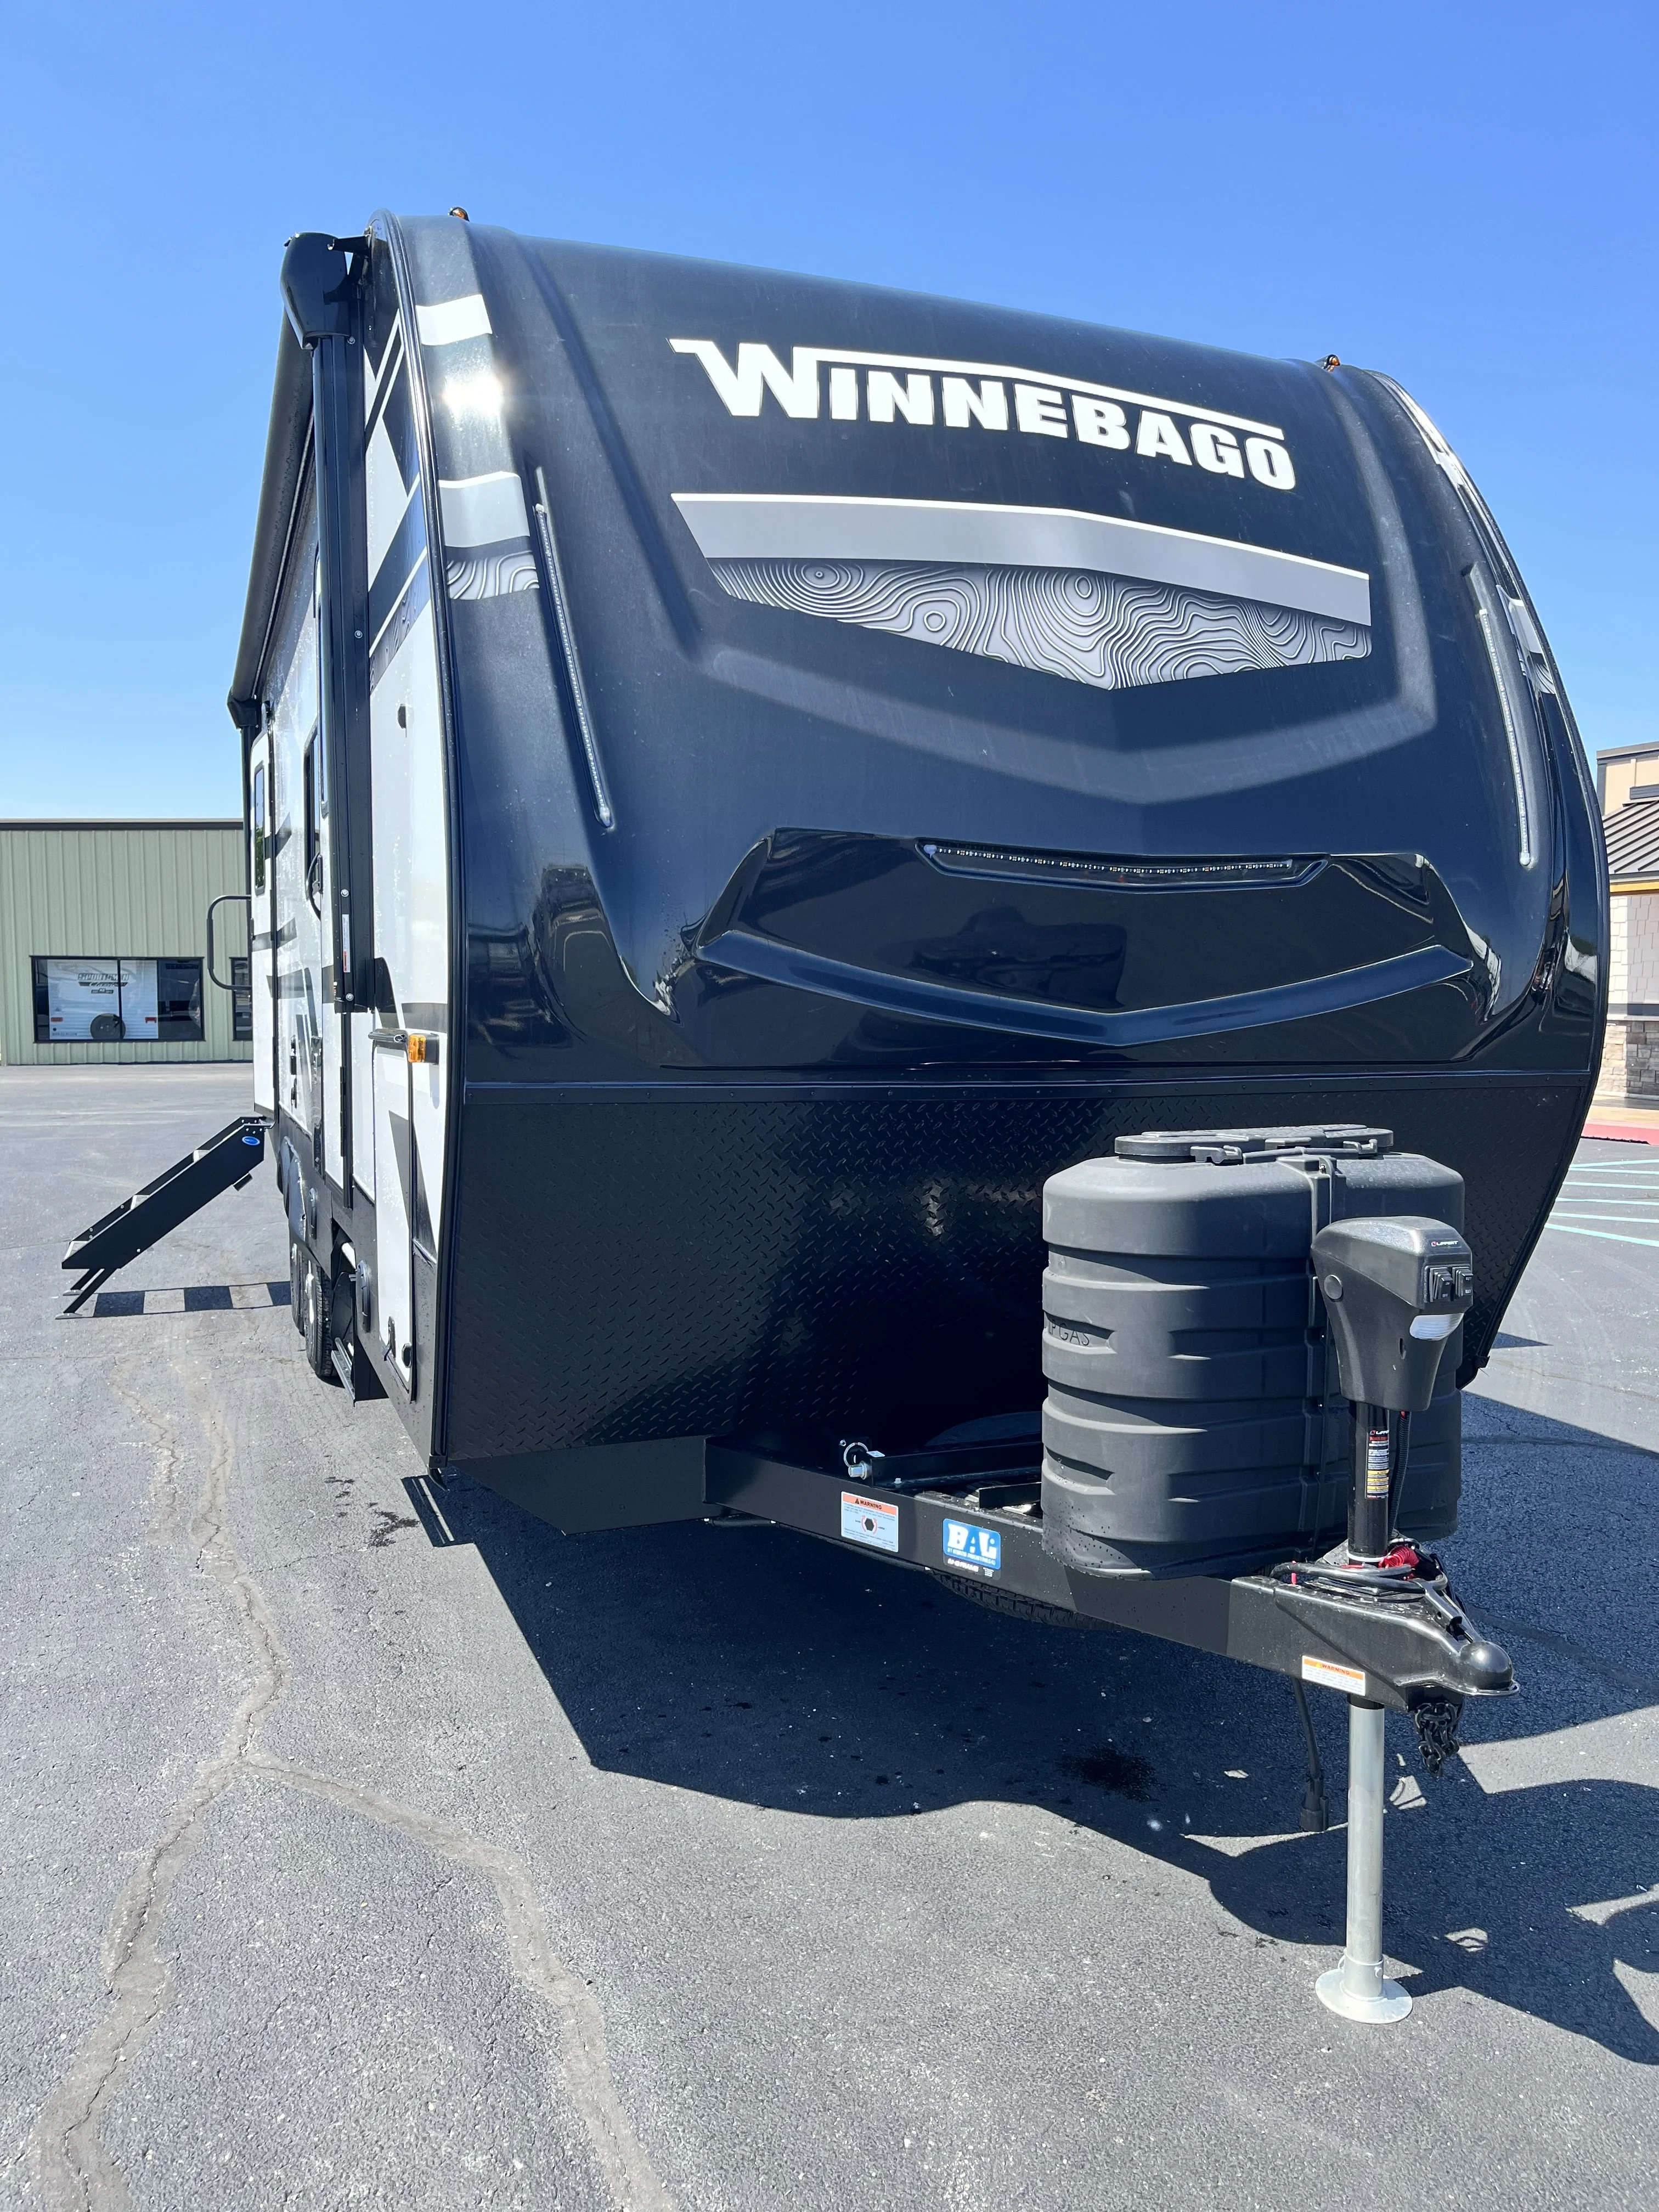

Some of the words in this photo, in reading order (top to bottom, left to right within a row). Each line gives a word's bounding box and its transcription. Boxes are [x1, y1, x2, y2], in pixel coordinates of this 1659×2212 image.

[667, 338, 1297, 491] WINNEBAGO
[1059, 1322, 1090, 1346] GAS
[860, 1500, 882, 1510] WARNING
[947, 1523, 997, 1560] BAL
[1322, 1663, 1350, 1675] WARNING
